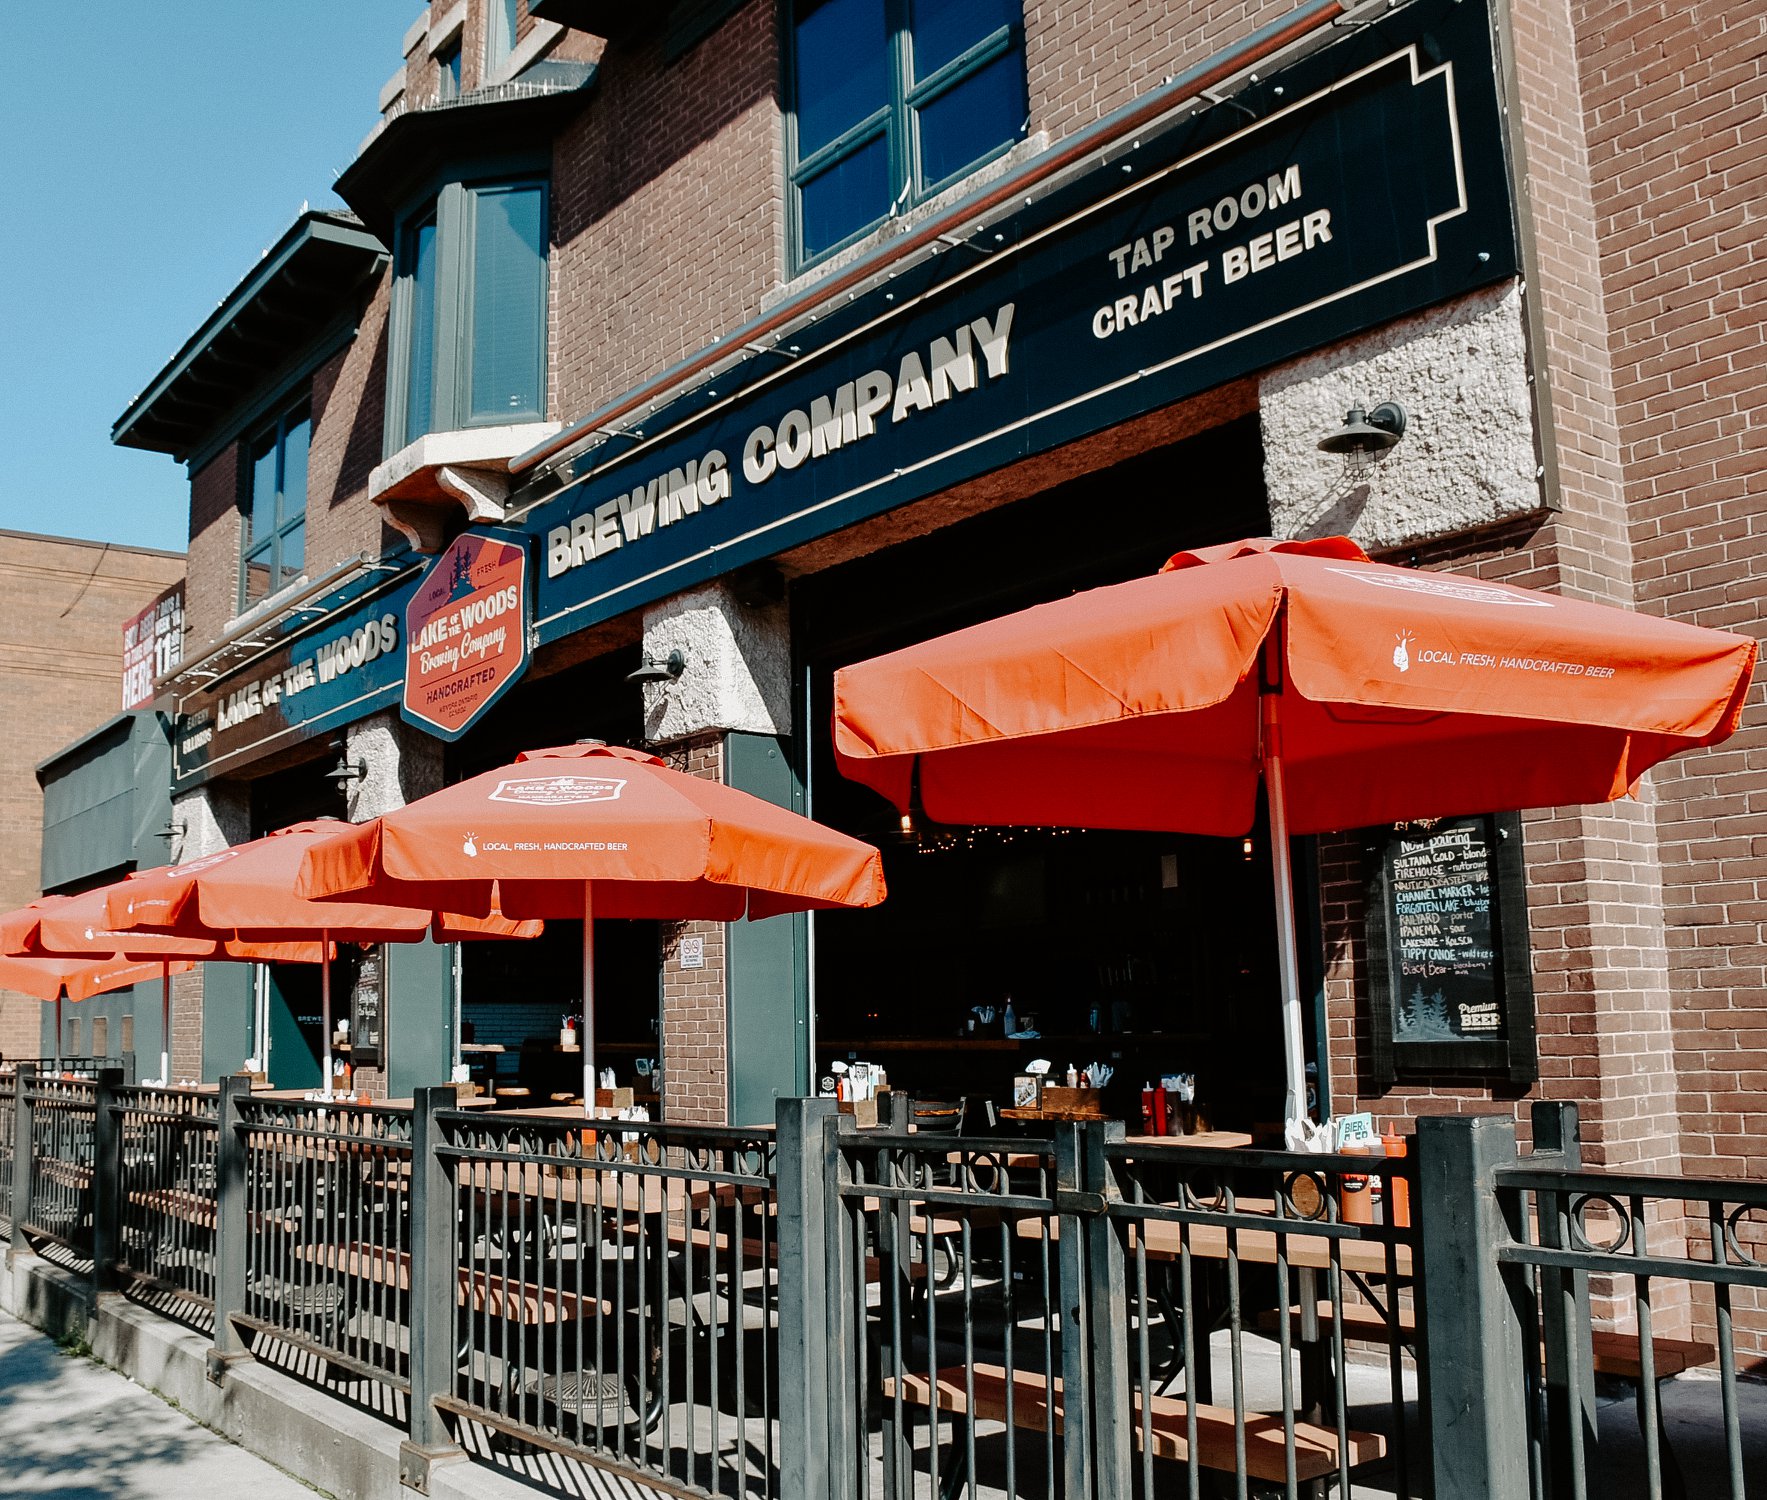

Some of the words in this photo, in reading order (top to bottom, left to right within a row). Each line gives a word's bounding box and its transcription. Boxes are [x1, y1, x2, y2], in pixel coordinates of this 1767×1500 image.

[1109, 225, 1175, 280] TAP
[1188, 163, 1302, 247] ROOM
[1092, 260, 1209, 339] CRAFT
[1222, 208, 1334, 285] BEER
[548, 449, 731, 579] BREWING
[741, 302, 1015, 485] COMPANY
[477, 561, 497, 577] FRESH
[428, 589, 447, 601] LOCAL
[459, 585, 517, 631] WOODS
[450, 612, 459, 626] OF
[411, 615, 448, 654] LAKE
[448, 622, 461, 638] THE
[154, 632, 171, 678] 11
[420, 645, 459, 675] Brewing
[461, 625, 507, 660] Company
[217, 680, 263, 732] LAKE
[262, 674, 282, 707] OF
[283, 658, 316, 697] THE
[316, 613, 398, 683] WOODS
[1417, 650, 1457, 666] LOCAL,
[1459, 653, 1497, 670] FRESH,
[1499, 657, 1584, 677] HANDCRAFTED
[1585, 665, 1615, 680] BEER
[122, 652, 154, 711] HERE
[426, 666, 495, 704] HANDCRAFTED
[482, 843, 512, 852] LOCAL,
[514, 842, 542, 852] FRESH,
[543, 842, 606, 851] HANDCRAFTED
[607, 842, 628, 851] BEER
[1400, 840, 1425, 854] Now
[1429, 833, 1470, 854] pouring
[1393, 855, 1432, 869] SULTANA
[1433, 851, 1455, 863] GOLD
[1395, 864, 1445, 880] FIREHOUSE
[1396, 889, 1438, 902] CHANNEL
[1438, 884, 1475, 899] MARKER
[1395, 901, 1439, 915] FORGOTTEN
[1440, 900, 1460, 912] LAKE
[1399, 913, 1440, 926] RAILYARD
[1451, 912, 1475, 924] porter
[1400, 925, 1441, 937] IPANEMA
[1449, 925, 1466, 933] sour
[1400, 937, 1440, 948] LAKESIDE
[1400, 948, 1427, 960] TIPPY
[1428, 948, 1457, 960] CANOE
[1402, 961, 1428, 978] Black
[1428, 961, 1446, 976] Bear
[1458, 1002, 1499, 1014] Premium
[1460, 1013, 1501, 1027] BEER
[1344, 1121, 1363, 1133] BIER
